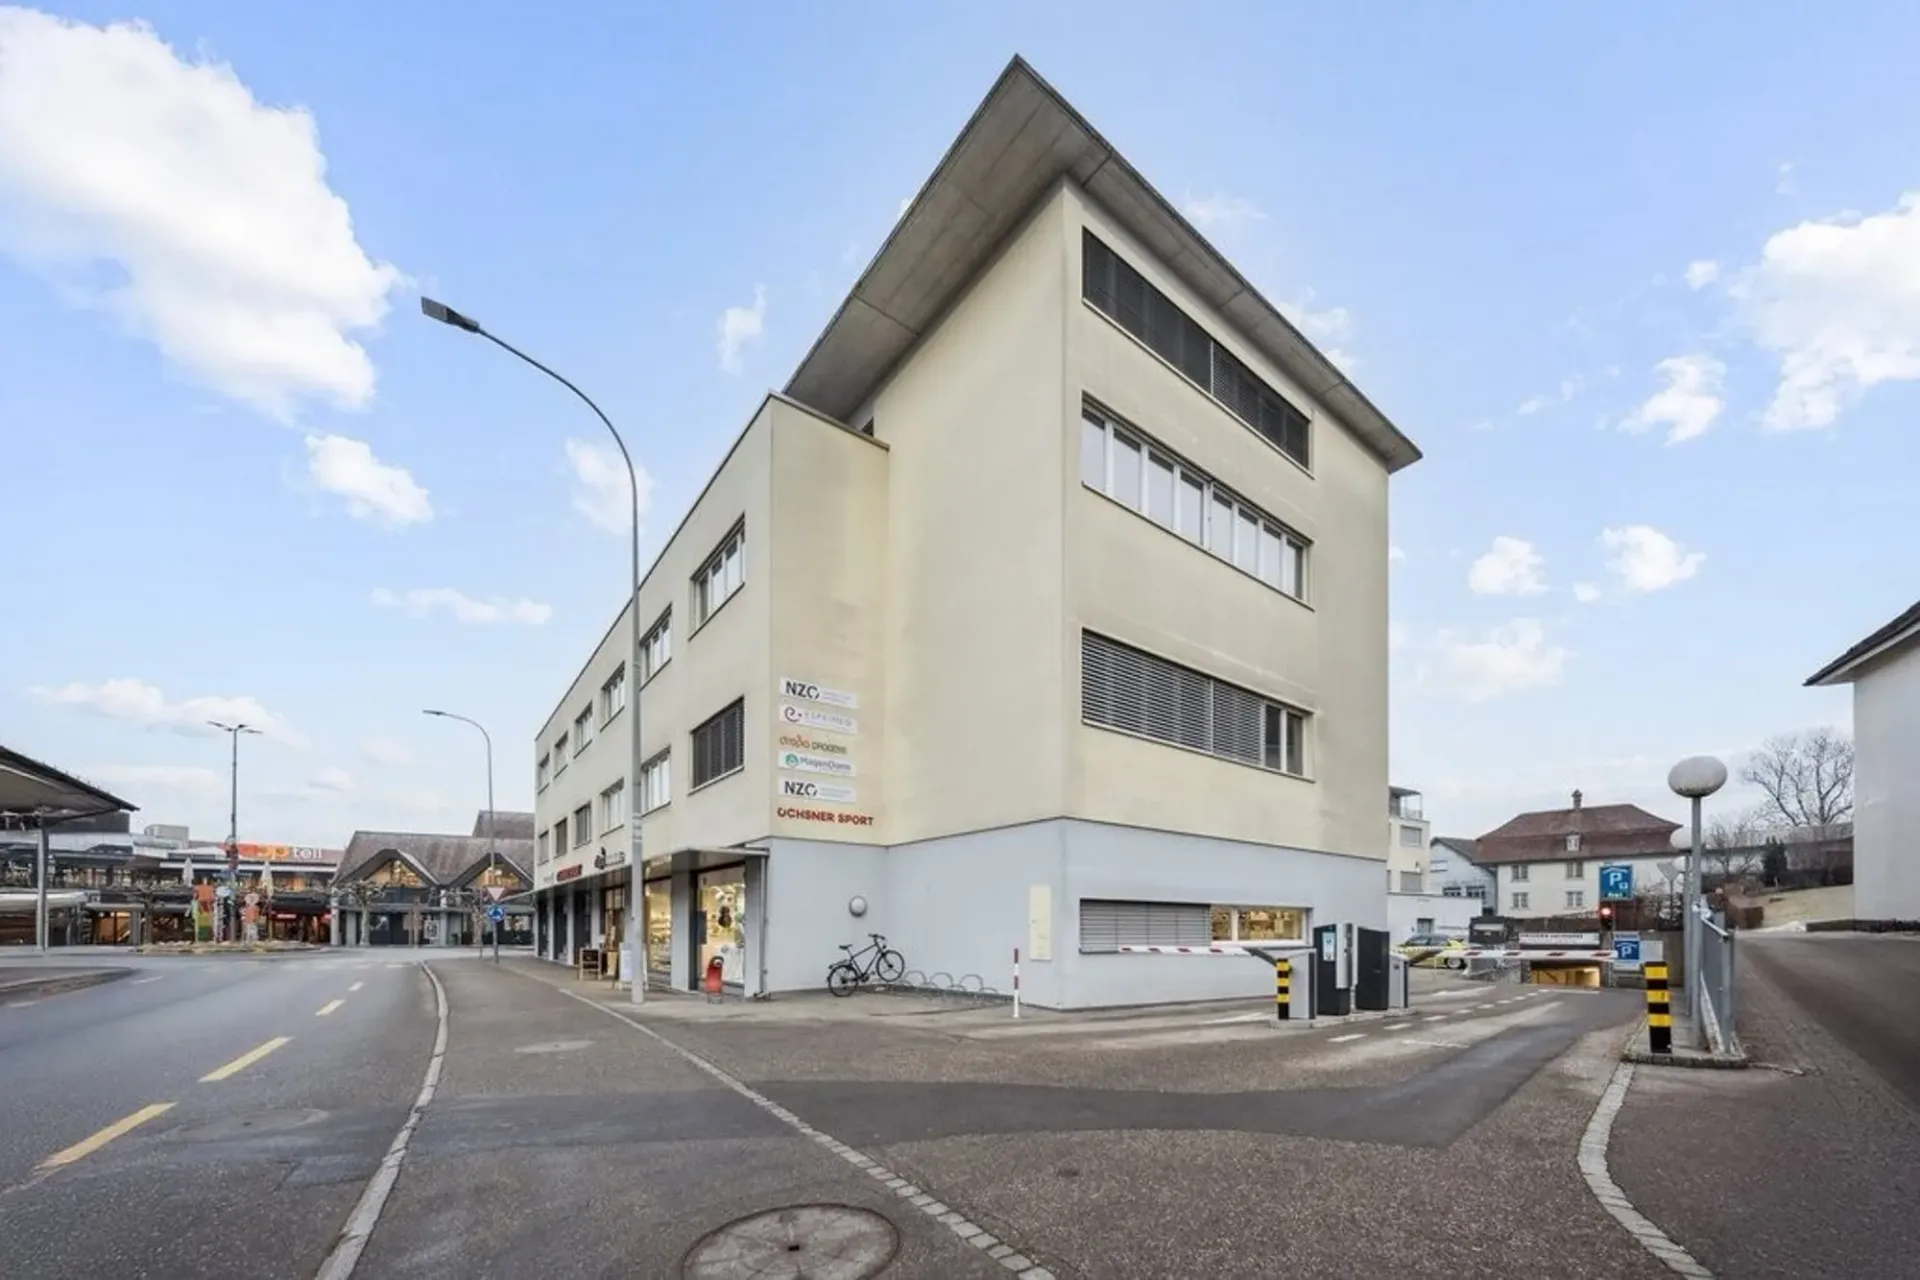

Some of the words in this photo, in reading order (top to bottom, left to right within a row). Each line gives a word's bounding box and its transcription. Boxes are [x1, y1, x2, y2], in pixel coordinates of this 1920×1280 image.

[777, 807, 835, 822] OCHSNER
[837, 813, 874, 826] SPORT
[1609, 872, 1622, 886] P
[1621, 946, 1632, 958] P
